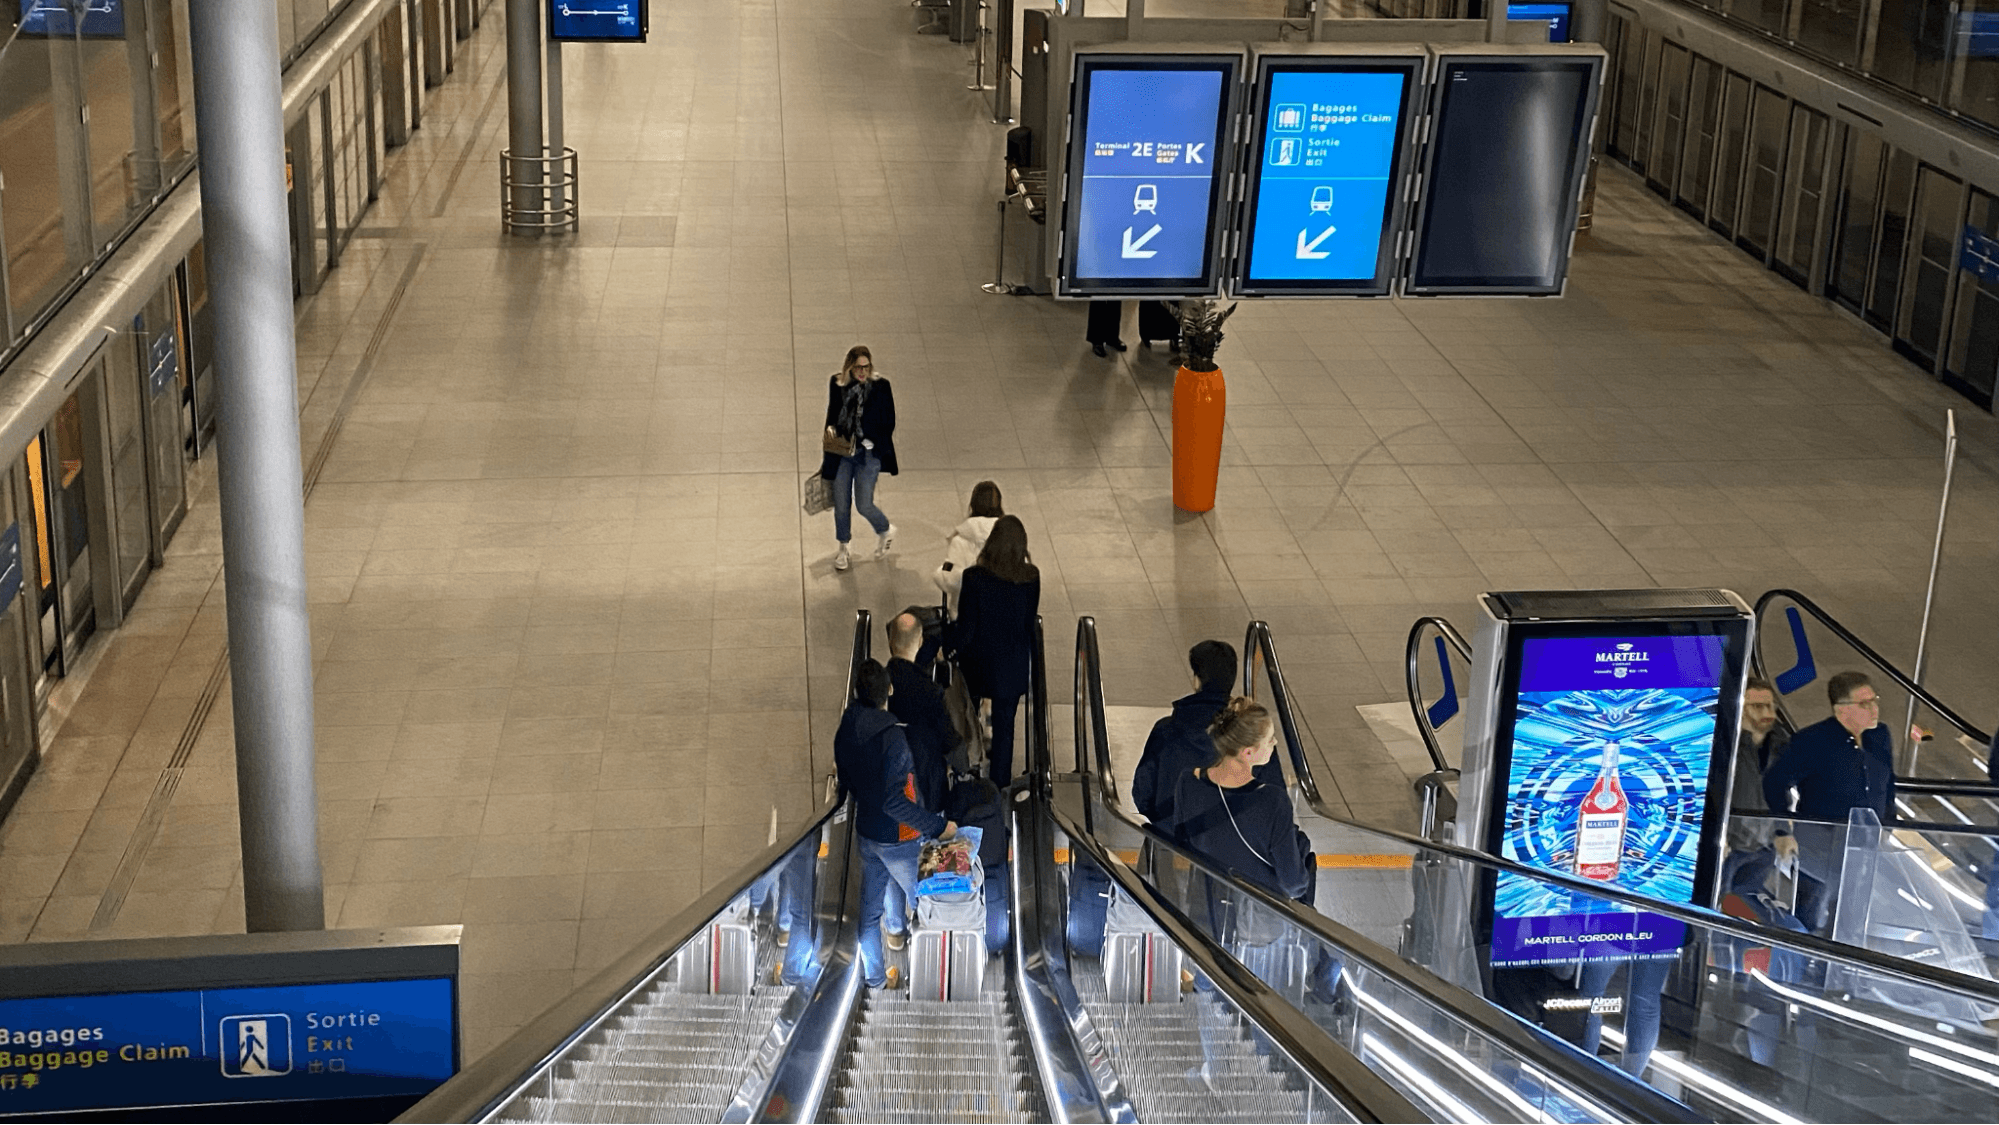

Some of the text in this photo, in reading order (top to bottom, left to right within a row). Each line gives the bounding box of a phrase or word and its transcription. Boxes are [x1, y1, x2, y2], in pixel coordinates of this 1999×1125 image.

[1312, 103, 1358, 114] Bagages
[1311, 113, 1392, 124] Baggage Claim
[1308, 138, 1340, 147] Sortie
[1132, 142, 1154, 157] 2E
[1185, 142, 1206, 164] K
[1306, 148, 1328, 157] Exit
[1595, 651, 1650, 662] MARTELL
[1524, 936, 1576, 946] MARTELL
[1578, 933, 1623, 943] CORDON
[306, 1010, 380, 1029] Sortie
[307, 1034, 354, 1052] Exit
[119, 1042, 190, 1062] Claim
